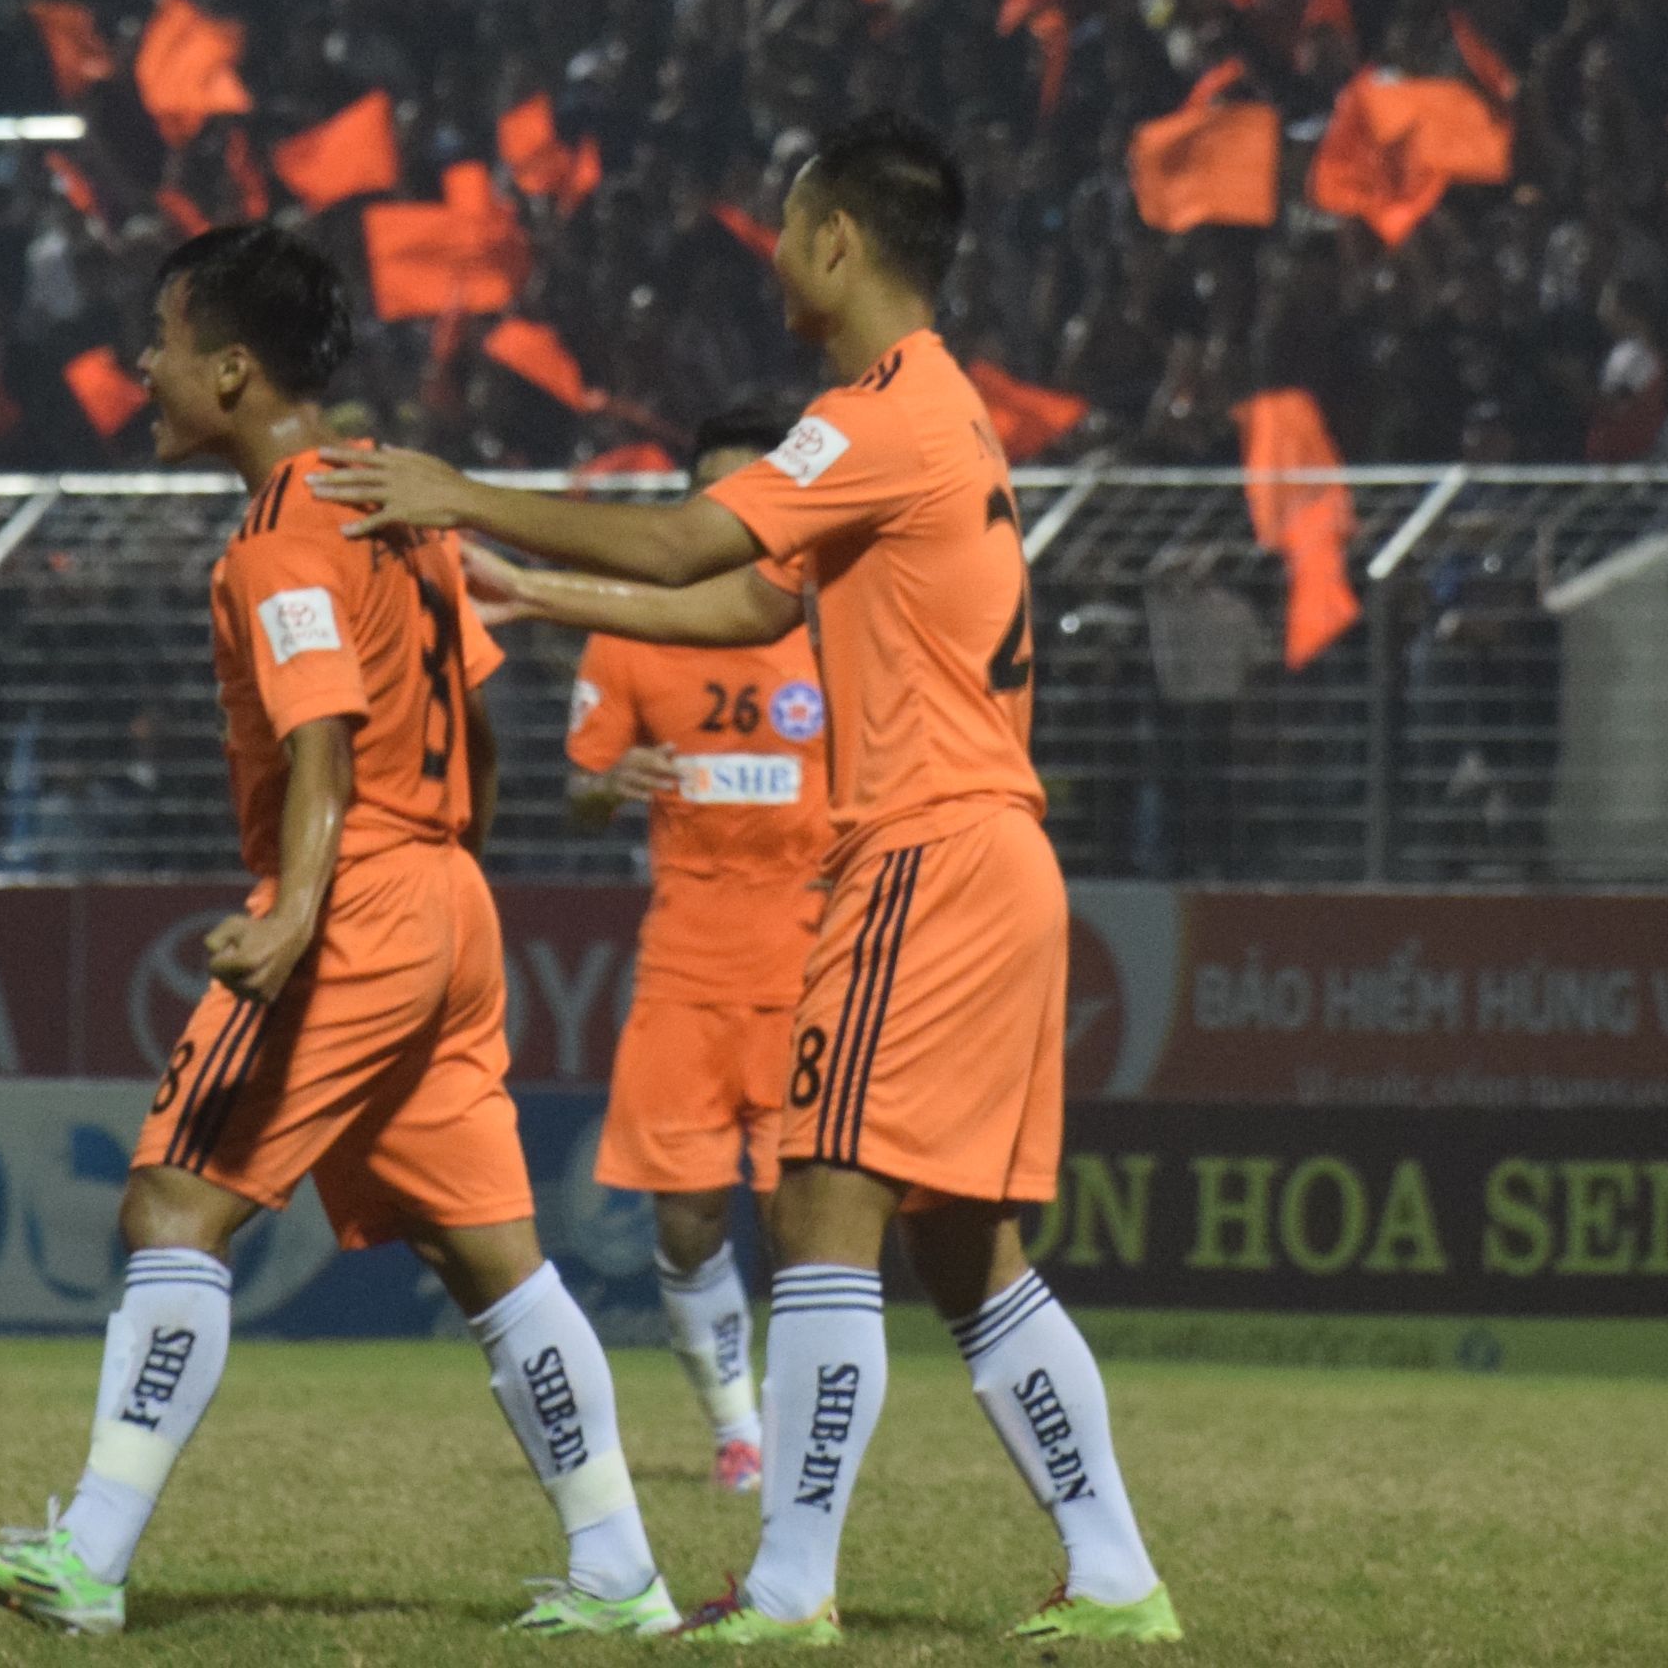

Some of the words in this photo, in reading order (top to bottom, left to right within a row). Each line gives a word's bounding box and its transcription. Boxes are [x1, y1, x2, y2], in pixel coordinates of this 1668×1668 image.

[698, 681, 762, 736] 26
[790, 1025, 827, 1110] 8
[1186, 1154, 1449, 1275] HOA
